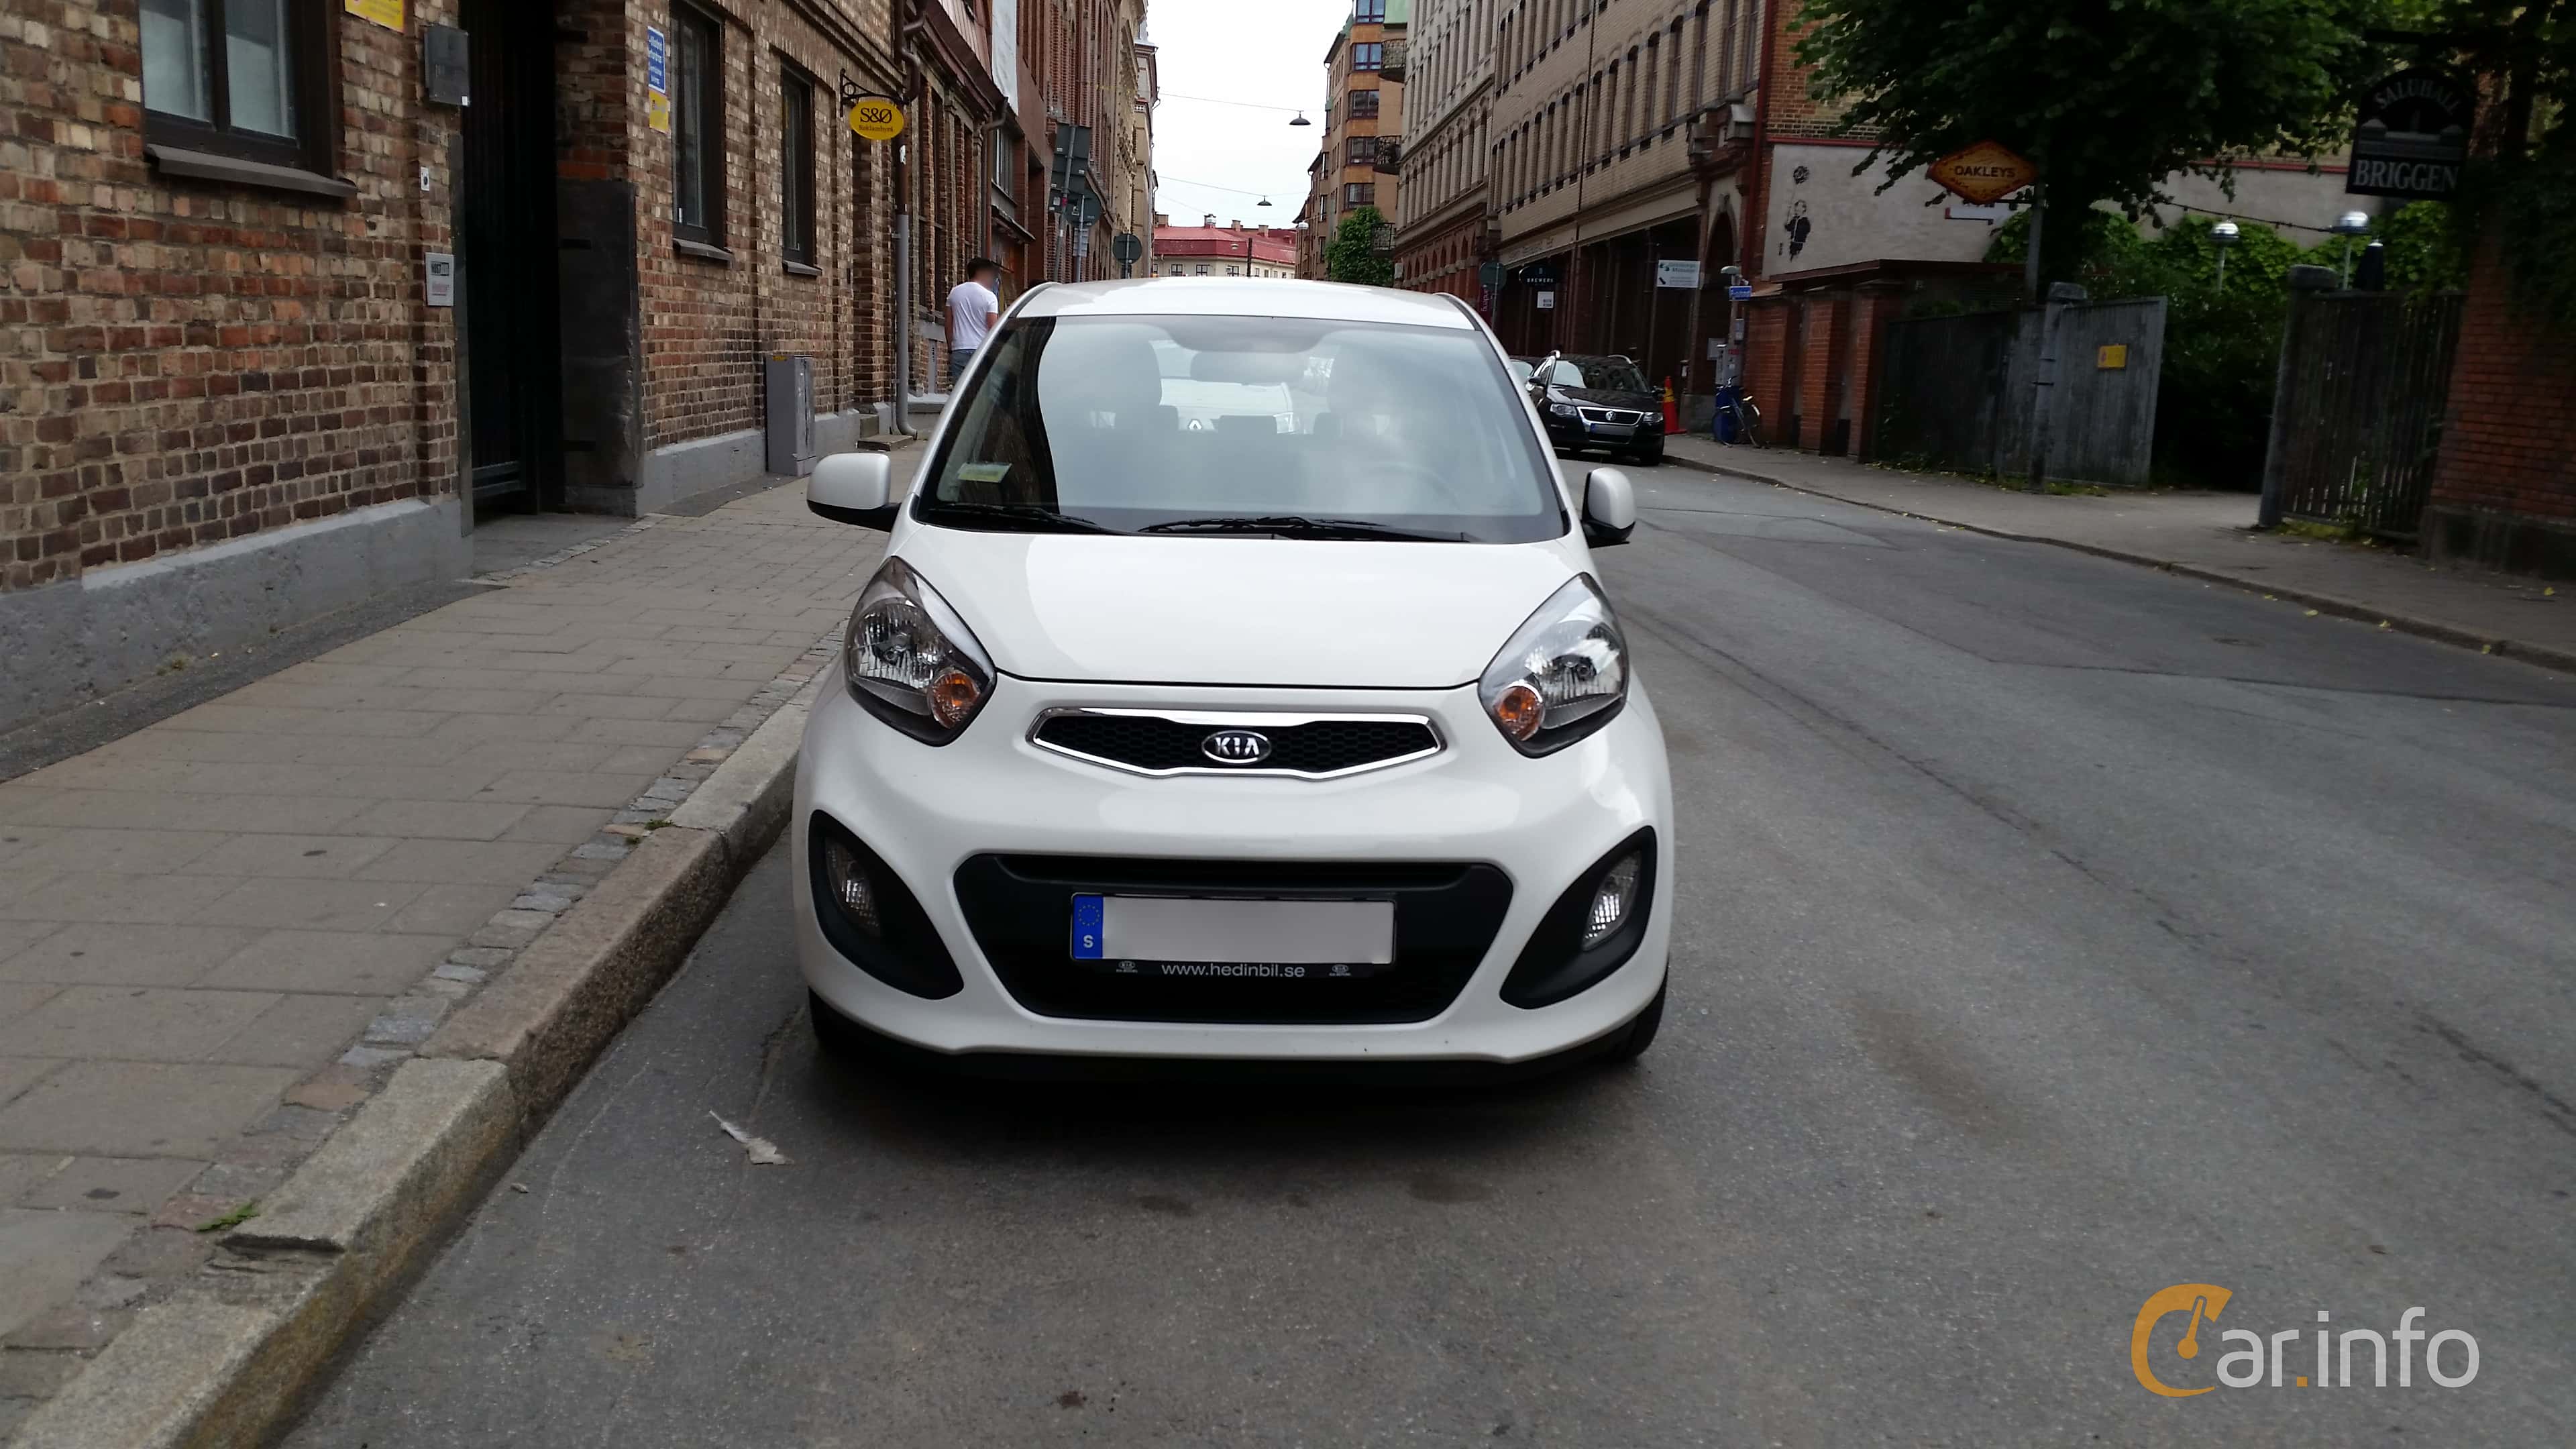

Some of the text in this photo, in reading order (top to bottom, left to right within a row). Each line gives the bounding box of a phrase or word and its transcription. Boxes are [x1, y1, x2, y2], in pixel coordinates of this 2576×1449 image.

[2373, 78, 2461, 116] SALUHALL
[859, 107, 892, 124] S&Ø
[1954, 166, 2016, 178] OAKLEYS
[2353, 159, 2459, 193] BRIGGEN
[1214, 737, 1260, 756] KIA
[1083, 934, 1094, 949] S
[1161, 963, 1305, 977] www.hedinbil.se
